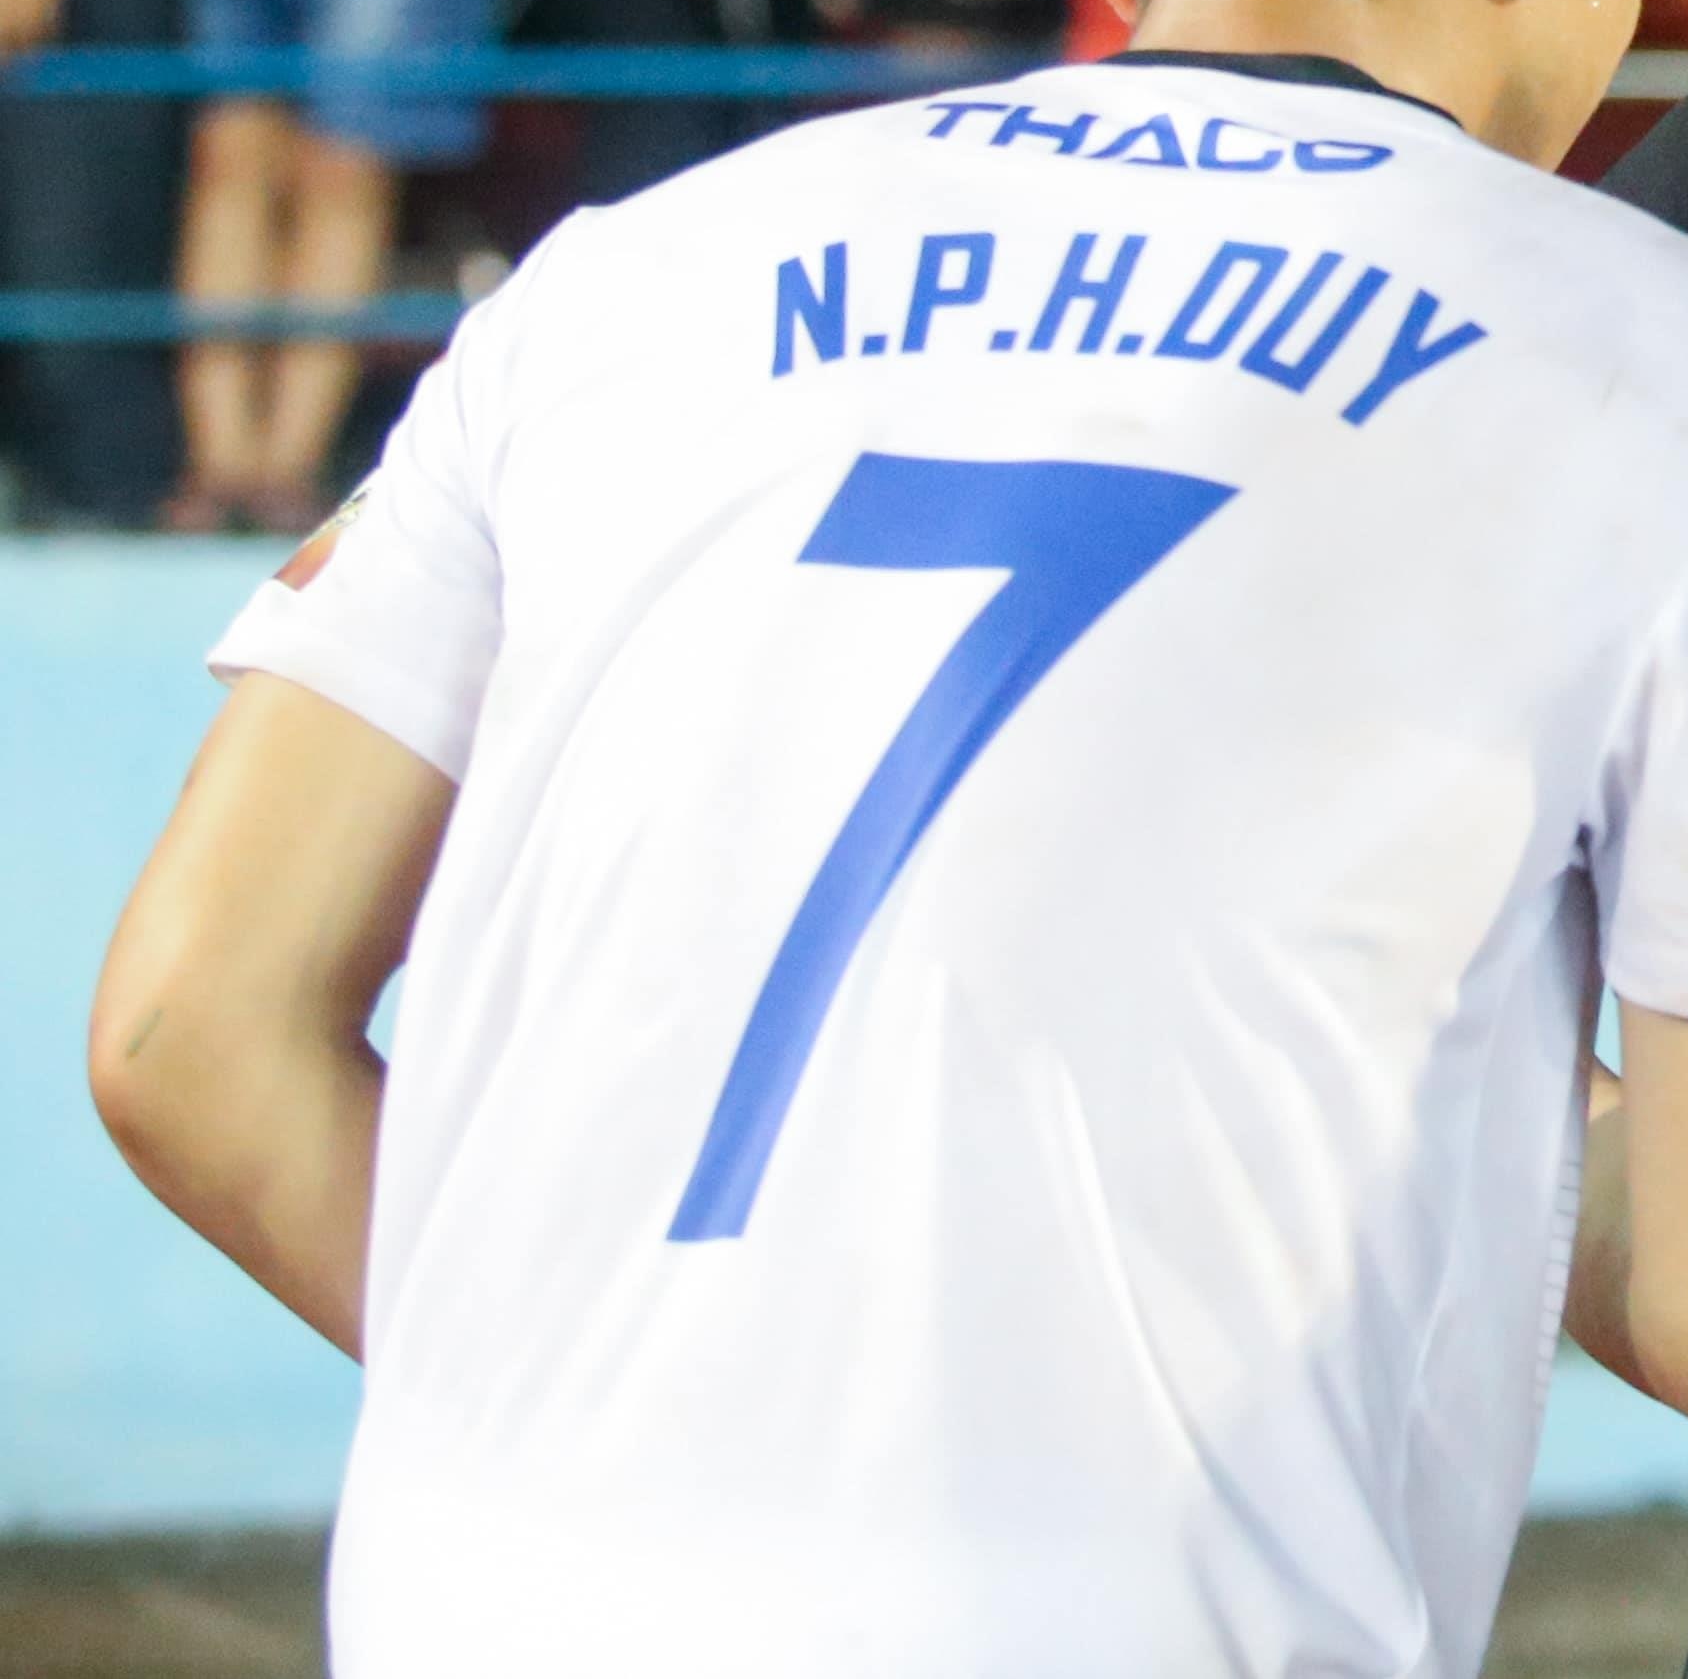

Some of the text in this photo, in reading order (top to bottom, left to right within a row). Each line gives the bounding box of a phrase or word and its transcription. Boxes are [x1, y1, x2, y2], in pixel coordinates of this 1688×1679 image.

[921, 101, 1395, 174] THACO
[770, 232, 1490, 428] N.P.H.DUY
[665, 451, 1243, 1243] 7
